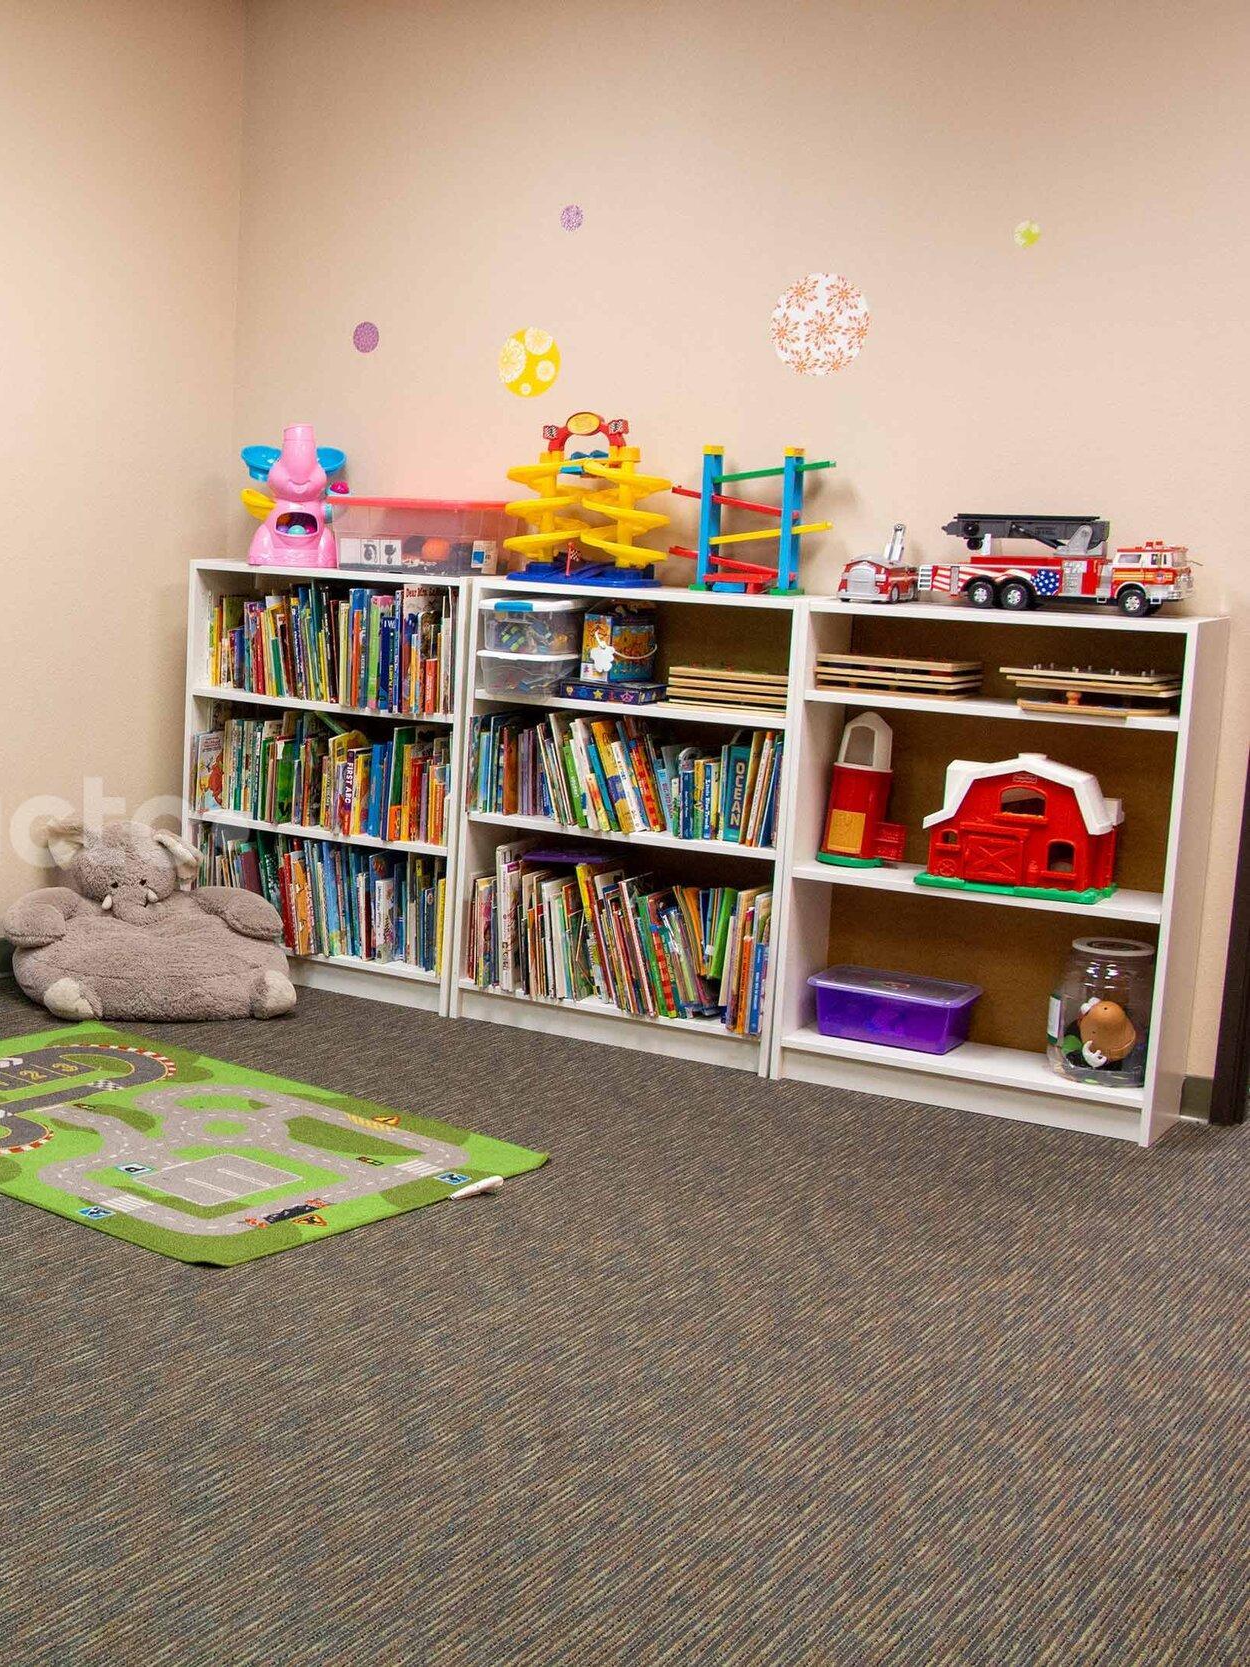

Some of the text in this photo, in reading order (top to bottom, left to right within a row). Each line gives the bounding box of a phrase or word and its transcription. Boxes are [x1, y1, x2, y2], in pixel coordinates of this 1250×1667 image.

[346, 762, 354, 785] FIRST
[730, 761, 746, 827] OCEAN
[19, 1069, 48, 1081] 2
[51, 1062, 79, 1073] 3
